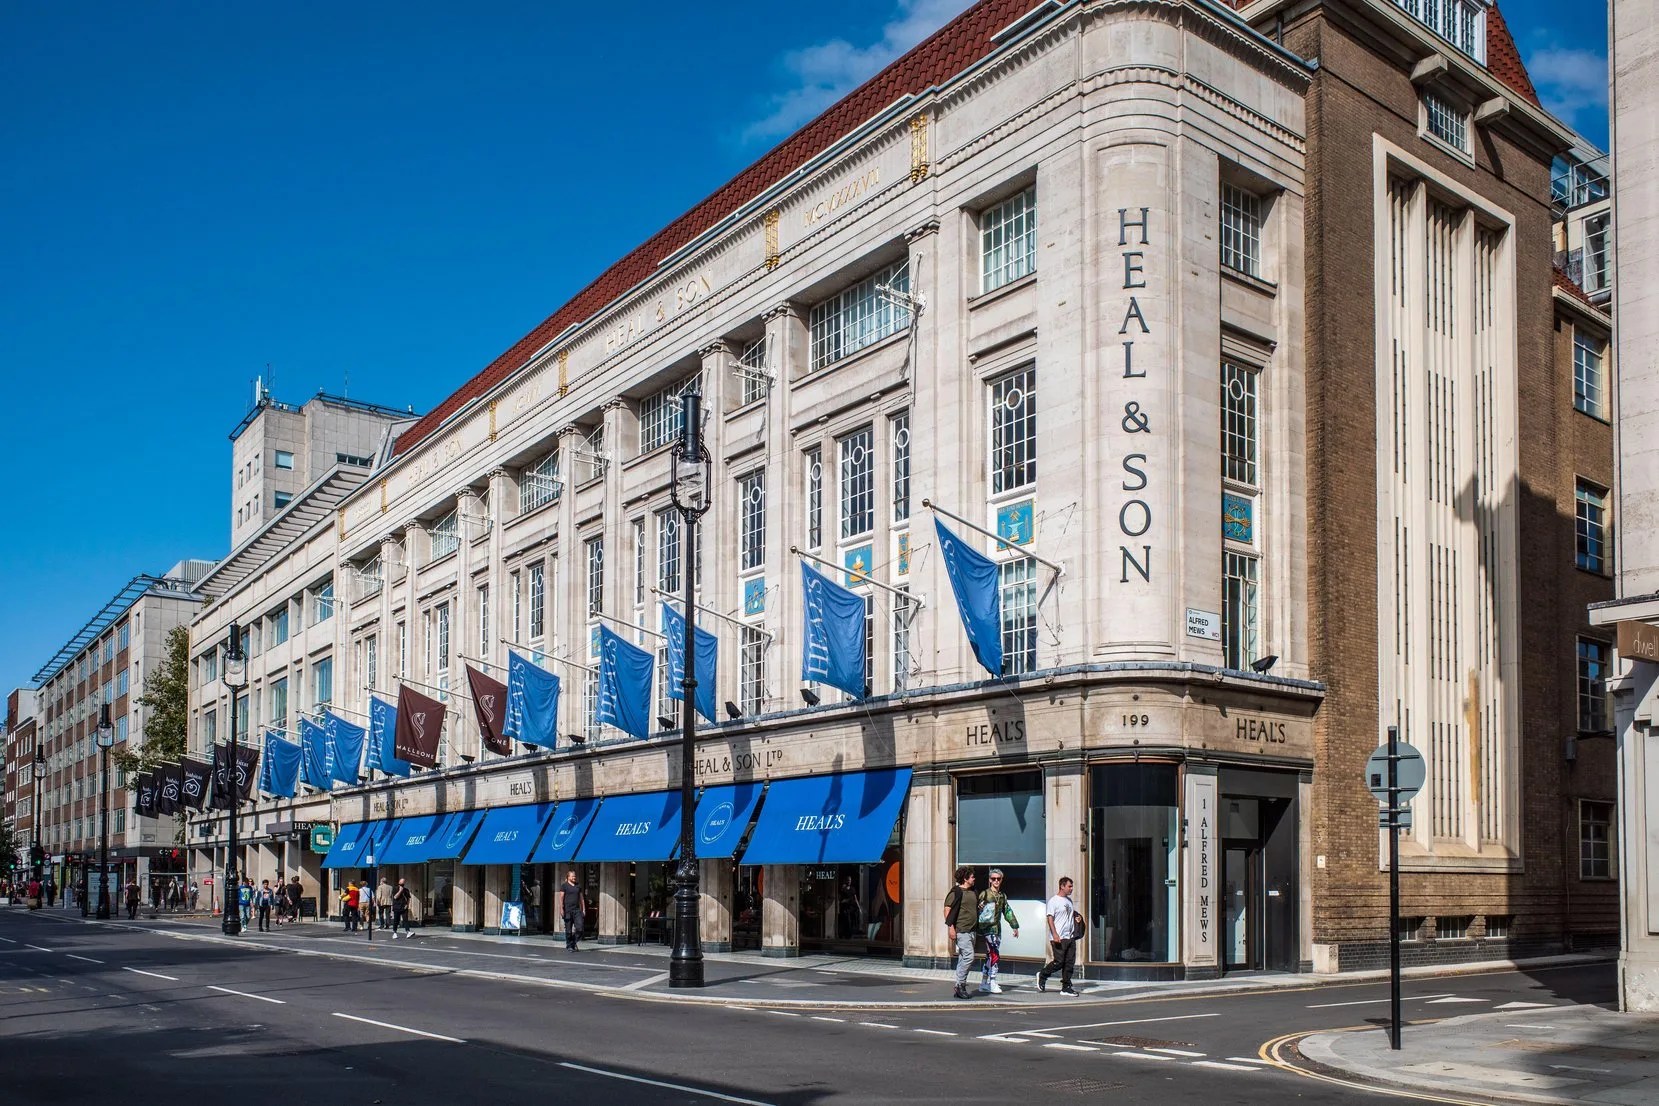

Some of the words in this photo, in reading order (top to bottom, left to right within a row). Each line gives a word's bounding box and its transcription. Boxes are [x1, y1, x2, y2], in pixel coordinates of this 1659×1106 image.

[1117, 206, 1151, 379] HEAL
[605, 313, 645, 355] HEAL
[656, 300, 665, 322] &
[677, 269, 711, 311] SON
[1121, 400, 1151, 434] &
[1118, 453, 1152, 584] SON
[1188, 616, 1209, 627] ALFRED
[1188, 625, 1206, 636] MEWS
[1633, 631, 1659, 657] dwell
[966, 720, 1024, 746] HEAL'S
[1122, 714, 1150, 727] 199
[1236, 717, 1286, 744] HEAL'S
[693, 758, 719, 775] HEAL
[722, 756, 731, 773] &
[736, 752, 761, 771] SON
[510, 781, 532, 796] HEAL'S
[616, 822, 652, 836] HEAL'S
[795, 814, 846, 831] HEAL'S
[494, 831, 519, 842] HEAL'S
[1200, 816, 1209, 889] ALFRED
[1199, 895, 1209, 943] MEWS
